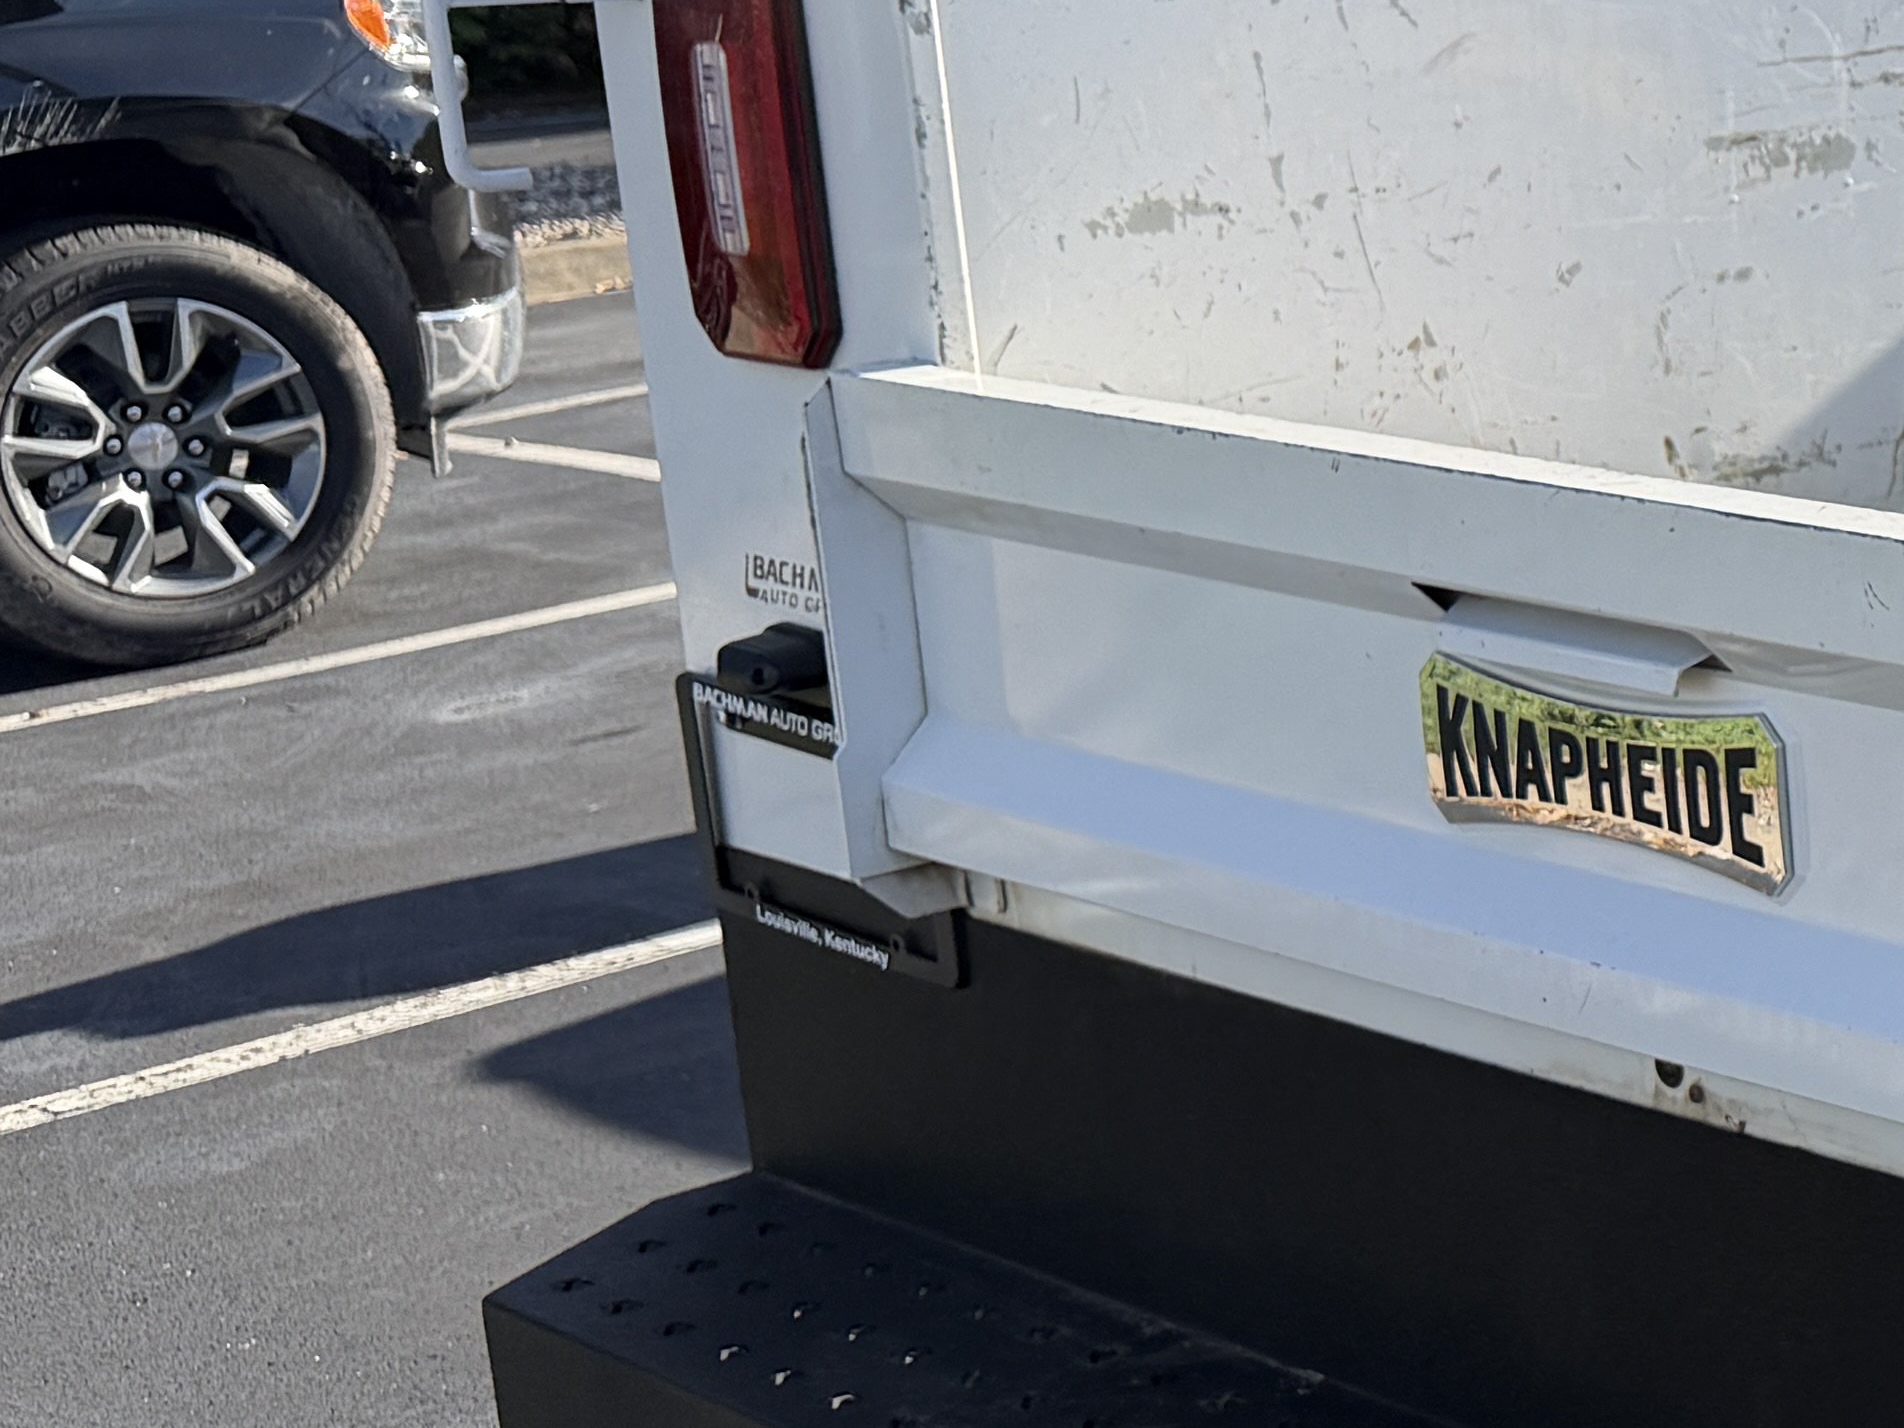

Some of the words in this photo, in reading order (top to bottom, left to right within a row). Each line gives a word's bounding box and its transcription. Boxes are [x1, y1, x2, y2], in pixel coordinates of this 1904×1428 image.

[760, 587, 799, 610] AUTO
[692, 681, 768, 724] BACHMAN
[770, 706, 809, 737] AUTO
[1436, 684, 1765, 868] KNAPHEIDE
[824, 928, 889, 972] Kentucky
